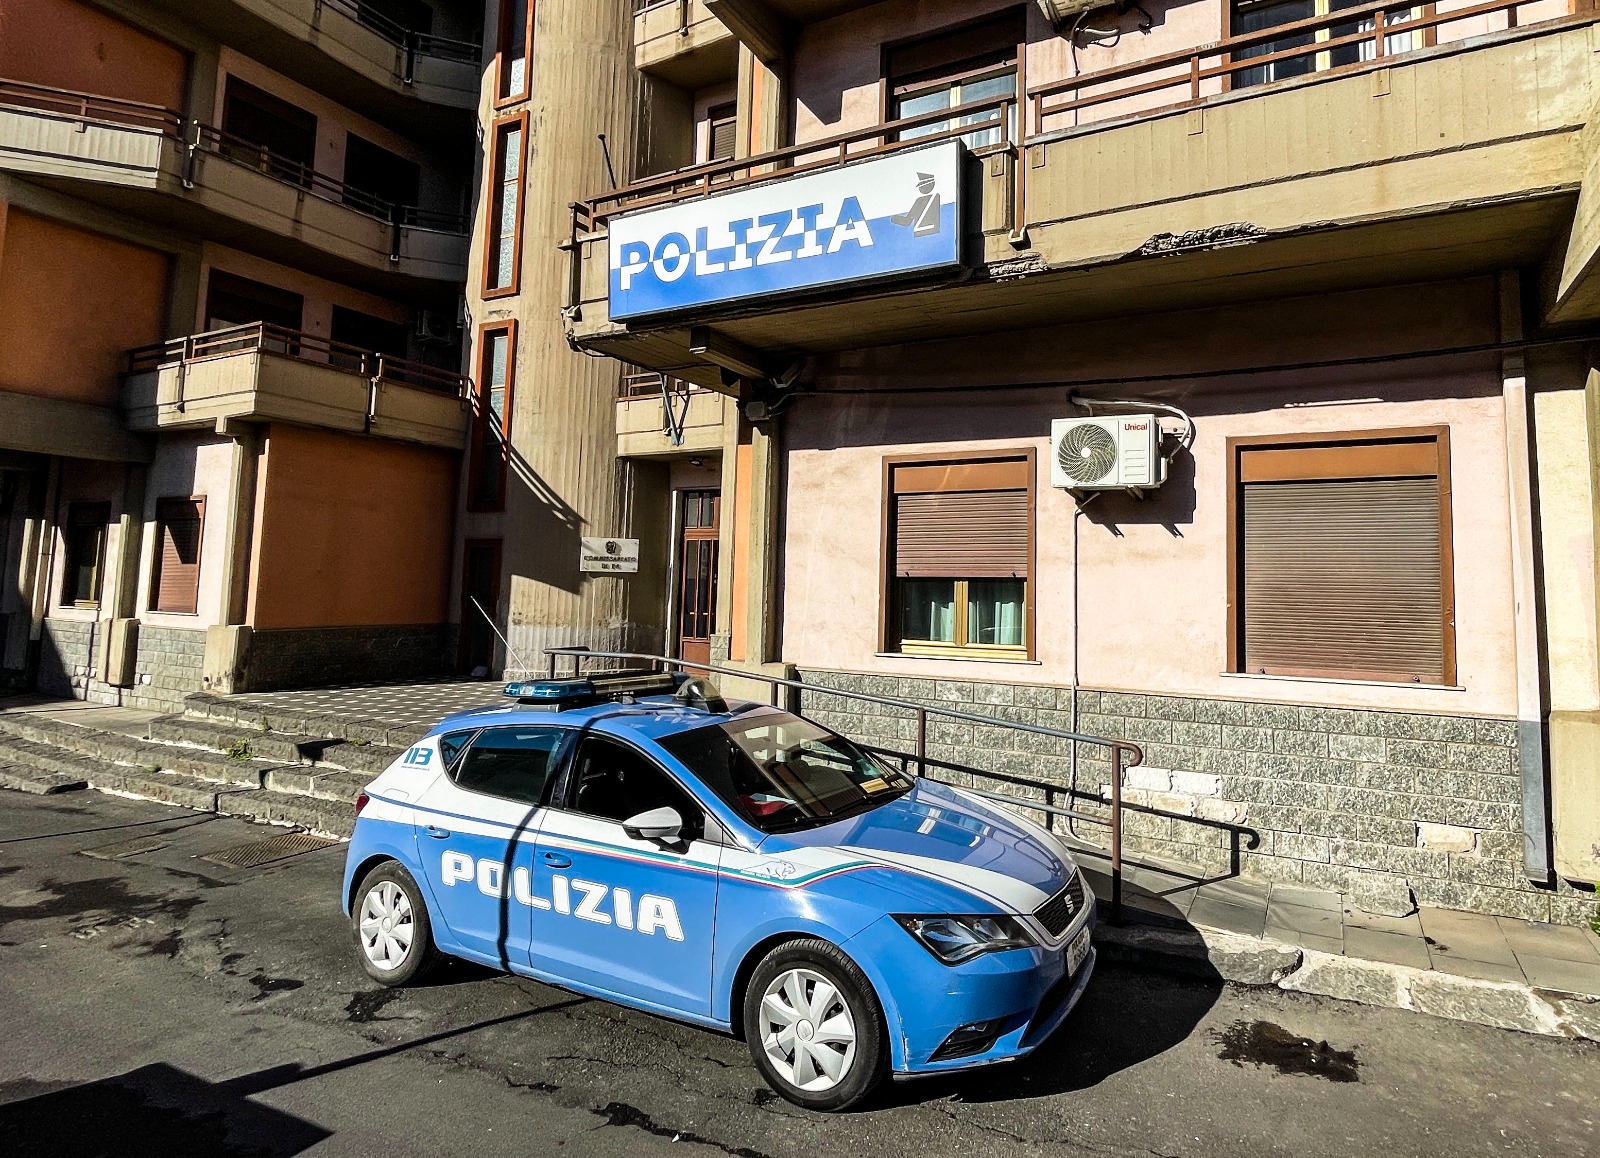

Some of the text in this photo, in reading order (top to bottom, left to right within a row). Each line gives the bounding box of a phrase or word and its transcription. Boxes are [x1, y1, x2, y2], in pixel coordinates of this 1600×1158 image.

[620, 195, 874, 291] POLIZIA
[1124, 422, 1148, 431] Unical
[403, 747, 434, 766] 113
[441, 850, 685, 942] POLIZIA
